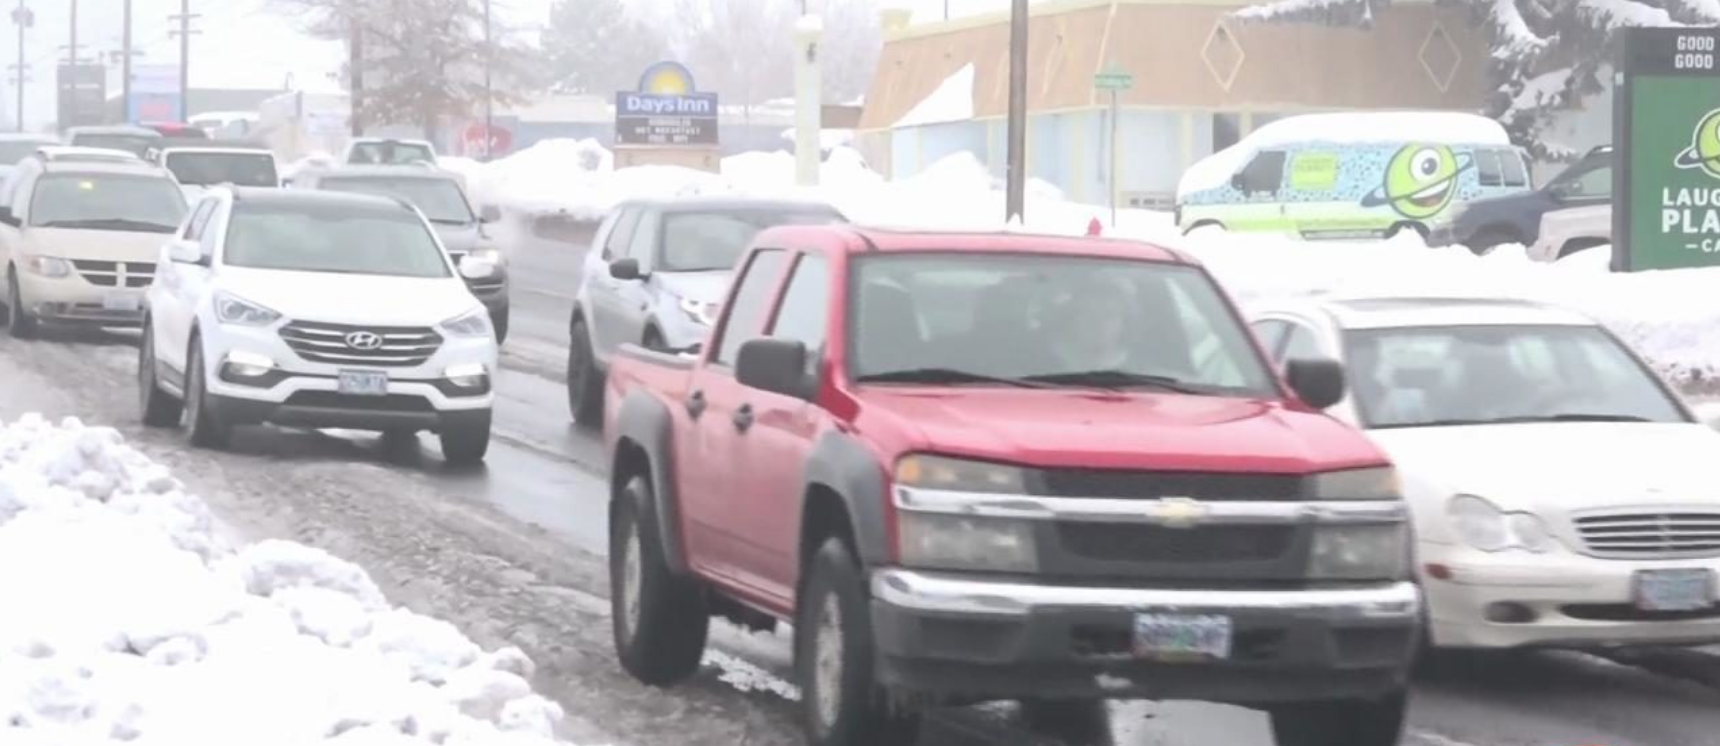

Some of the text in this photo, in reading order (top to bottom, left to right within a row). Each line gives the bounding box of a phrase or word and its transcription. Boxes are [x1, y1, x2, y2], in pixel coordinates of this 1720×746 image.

[1677, 35, 1715, 51] GOOD
[1675, 53, 1714, 69] GOOD
[1662, 209, 1720, 233] PLA
